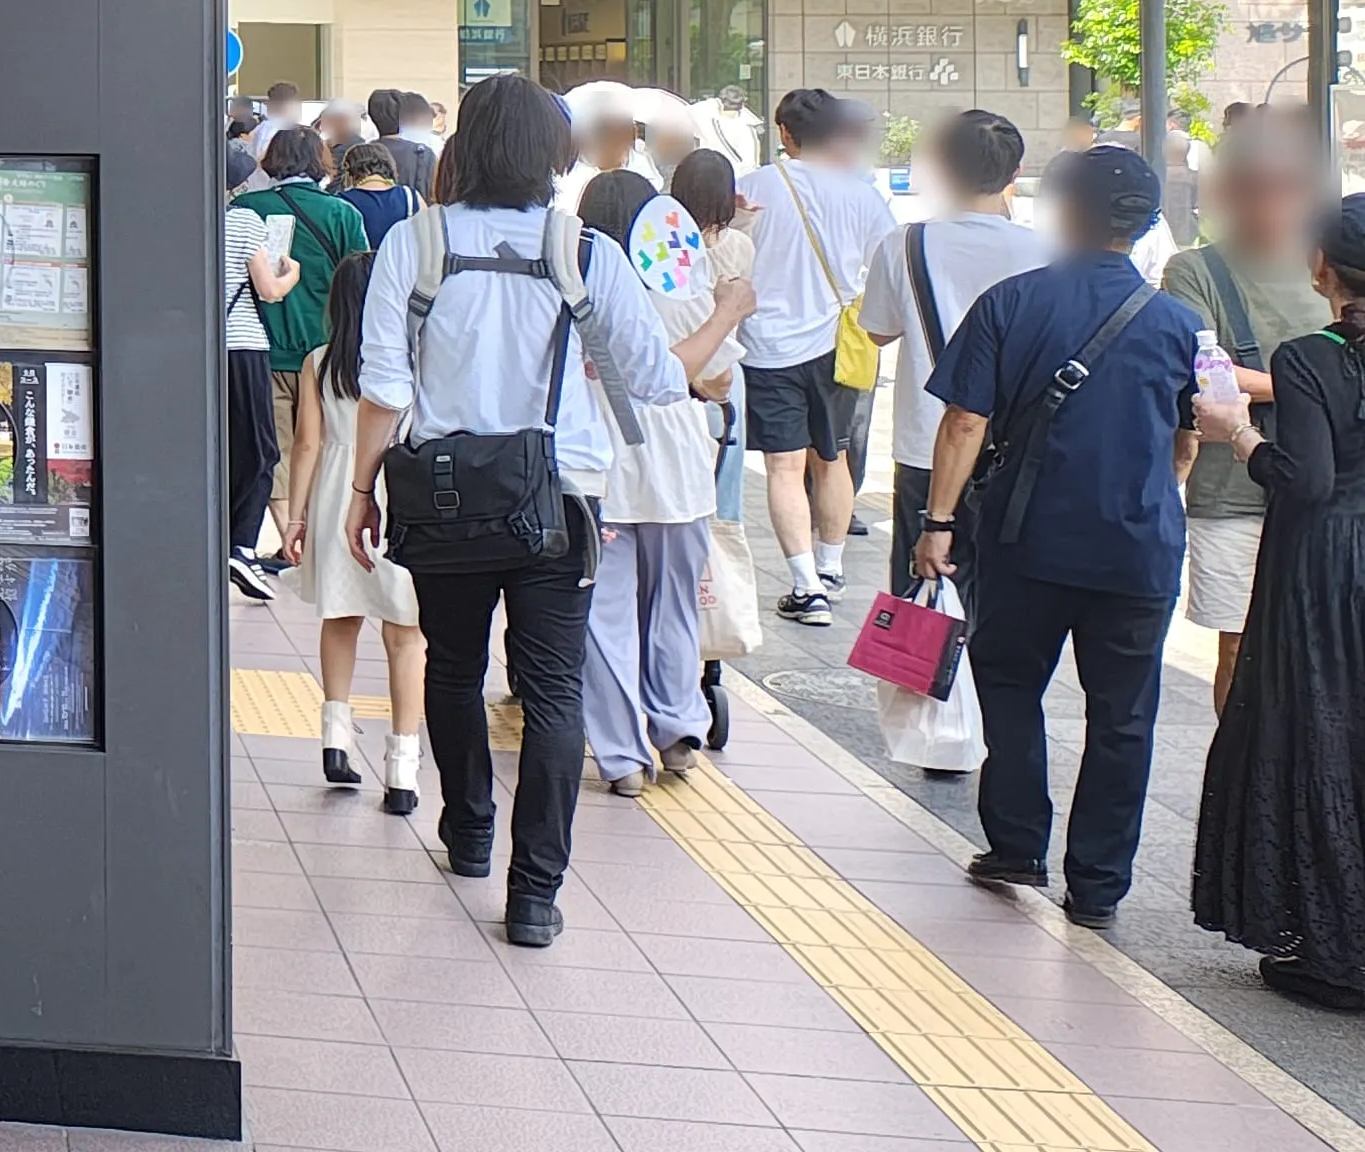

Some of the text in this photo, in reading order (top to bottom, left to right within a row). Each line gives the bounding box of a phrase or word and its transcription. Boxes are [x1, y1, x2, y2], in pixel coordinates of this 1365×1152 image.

[865, 25, 964, 47] 横浜銀行
[836, 64, 926, 81] 東日本銀行
